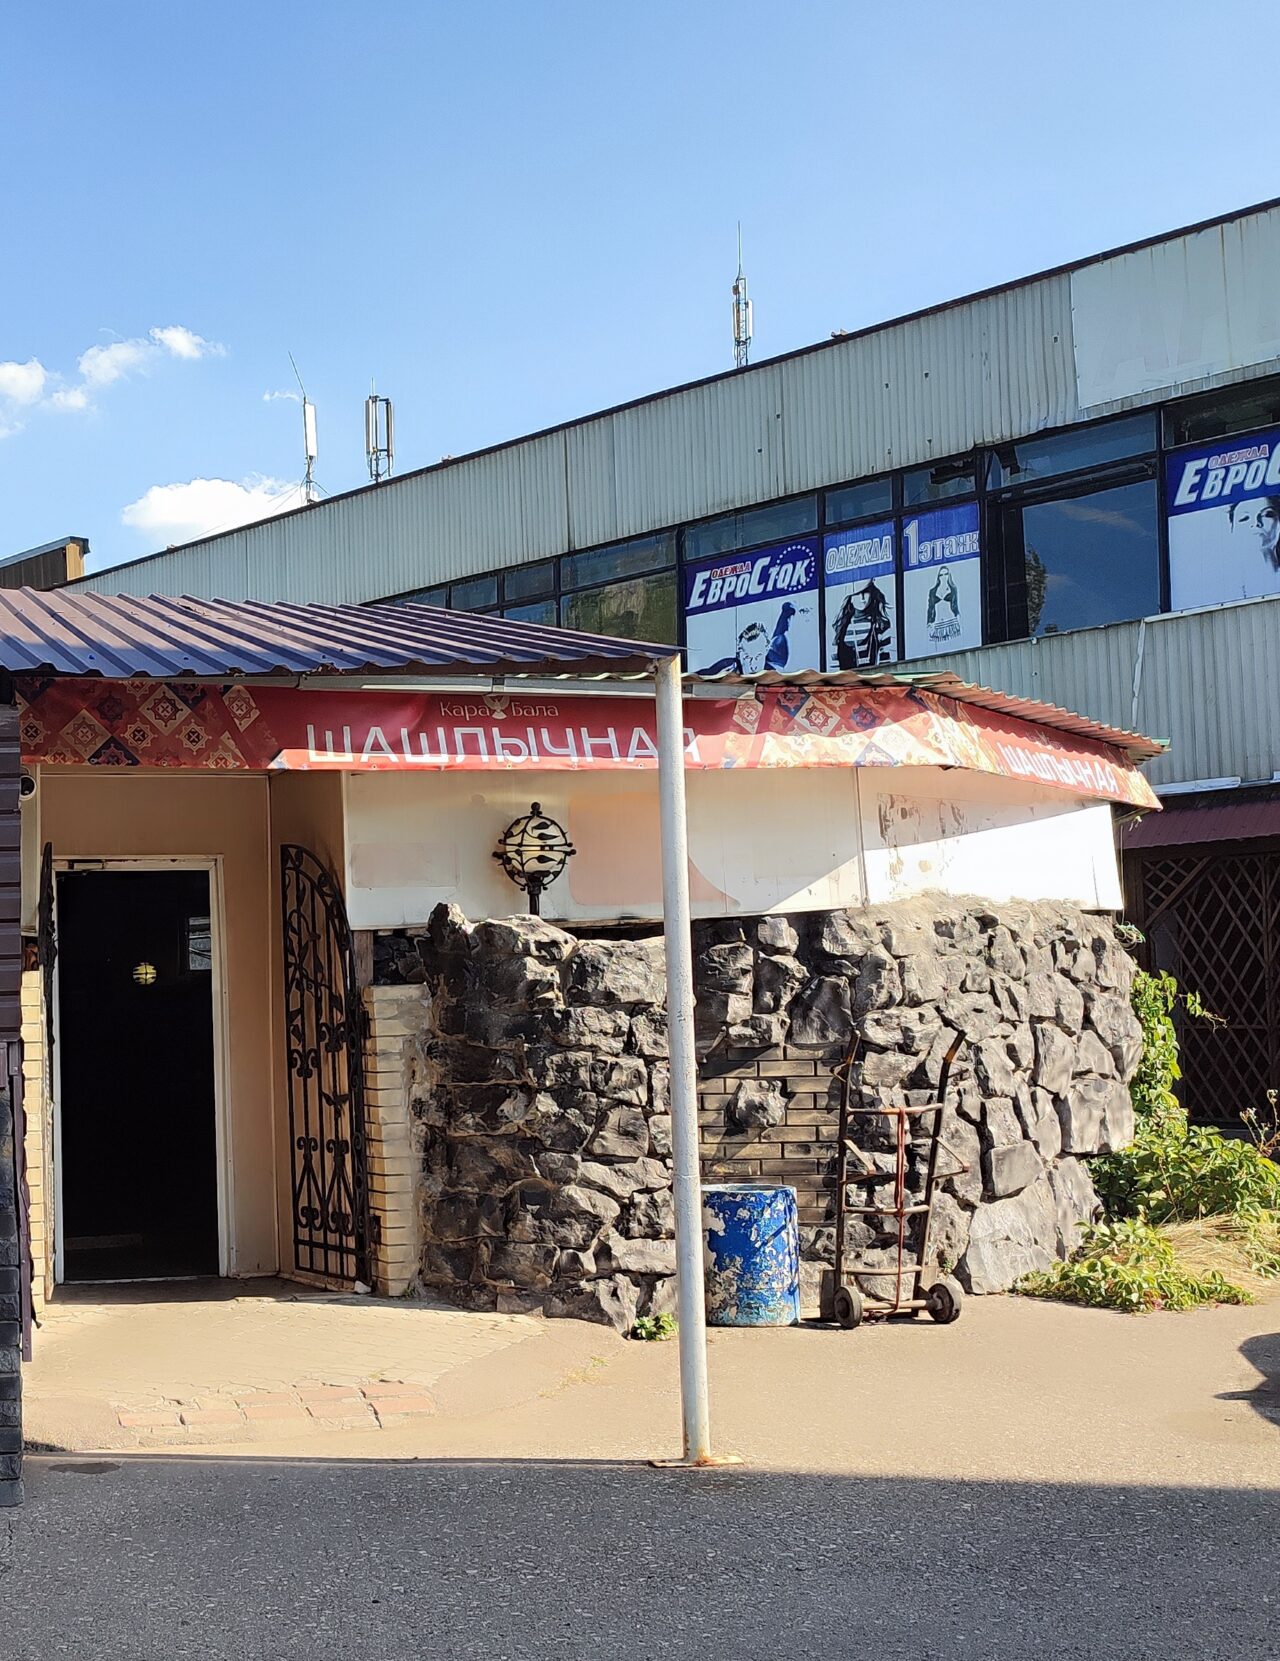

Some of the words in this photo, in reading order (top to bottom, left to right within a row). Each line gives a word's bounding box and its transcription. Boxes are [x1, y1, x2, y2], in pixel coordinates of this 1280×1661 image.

[825, 534, 893, 575] ОДЕЖДА
[904, 519, 918, 566] 1
[440, 701, 490, 721] Кара
[511, 701, 559, 718] Бала
[306, 724, 701, 763] ШАШЛЫЧНАЯ
[997, 742, 1120, 794] ШАШЛЫЧНАЯ
